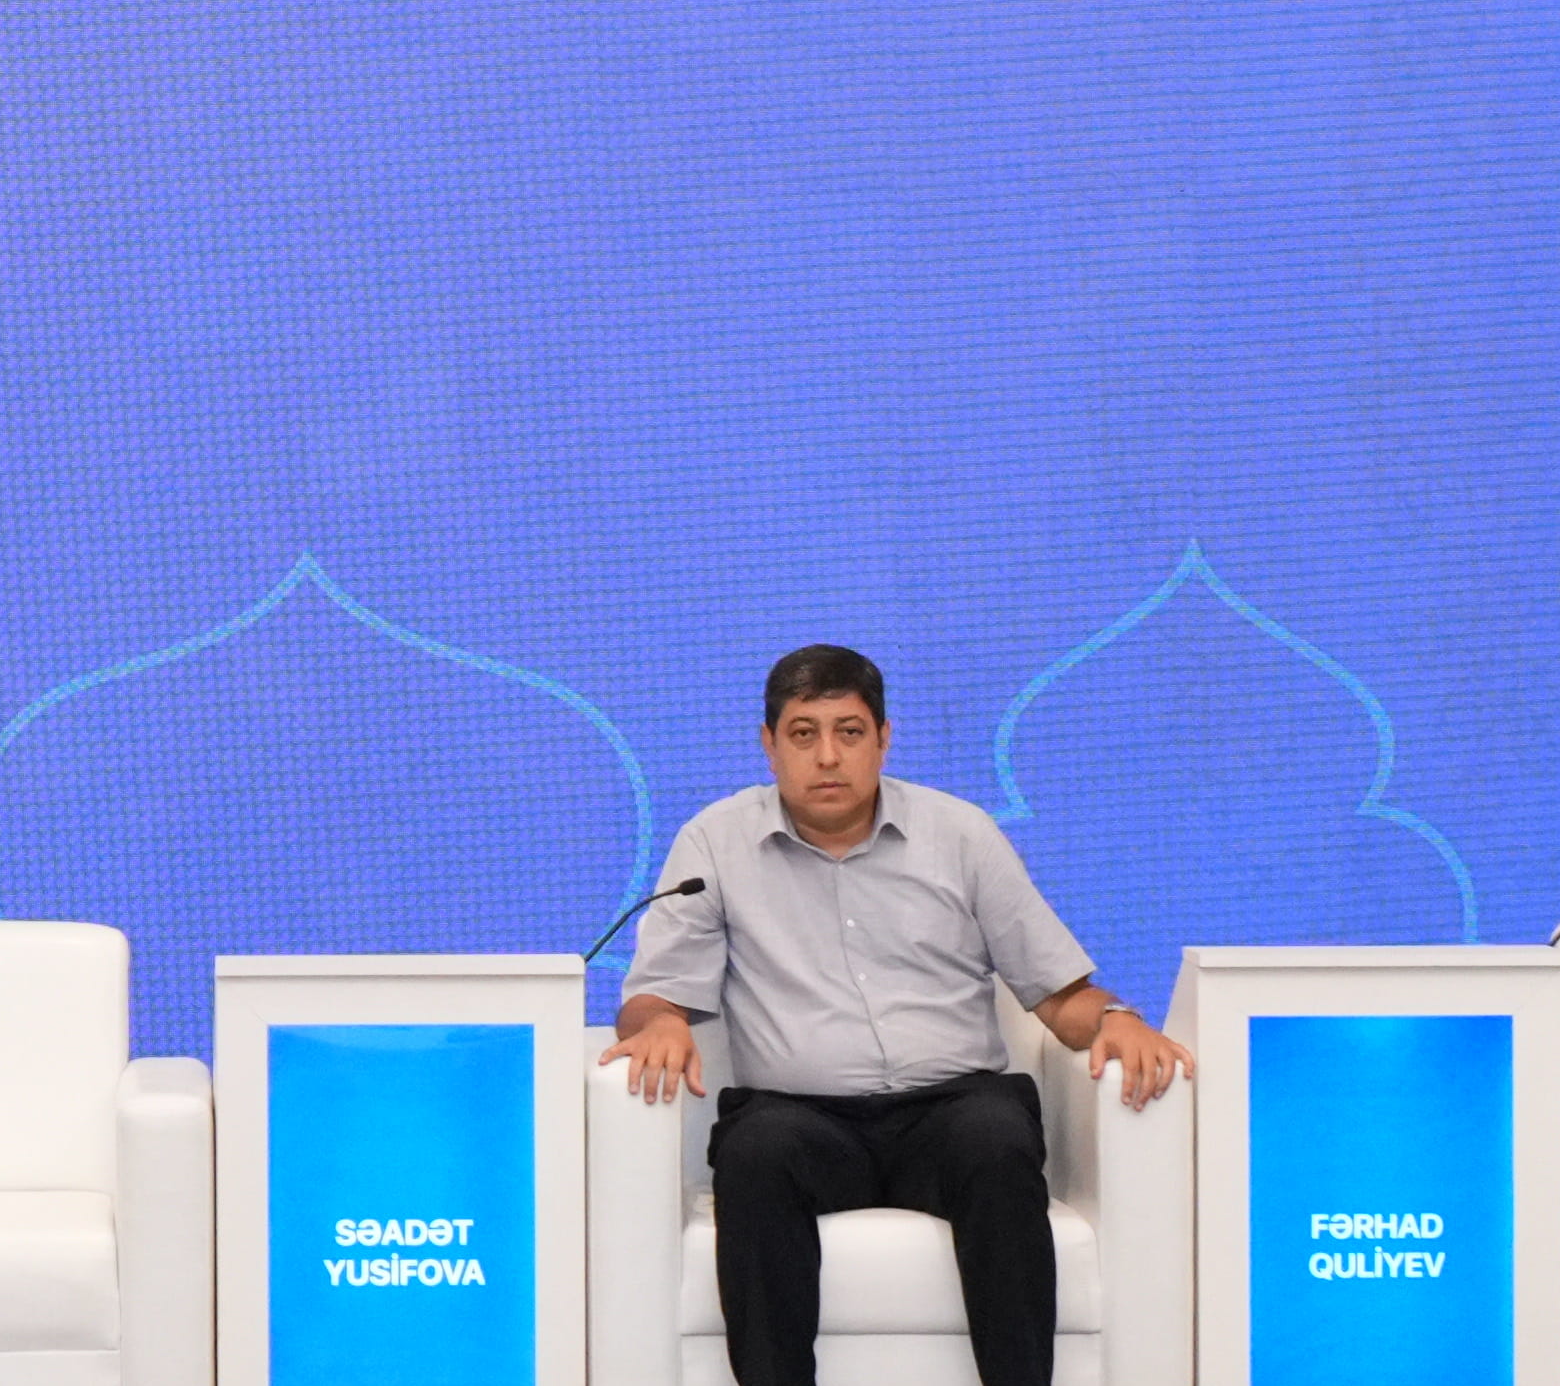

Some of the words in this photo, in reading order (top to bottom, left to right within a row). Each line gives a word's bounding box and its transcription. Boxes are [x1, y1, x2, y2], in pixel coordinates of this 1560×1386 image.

[335, 1218, 475, 1247] SƏADƏT
[1311, 1213, 1445, 1240] FƏRHAD
[323, 1252, 486, 1287] YUSİFOVA
[1309, 1246, 1446, 1281] QULİYEV
